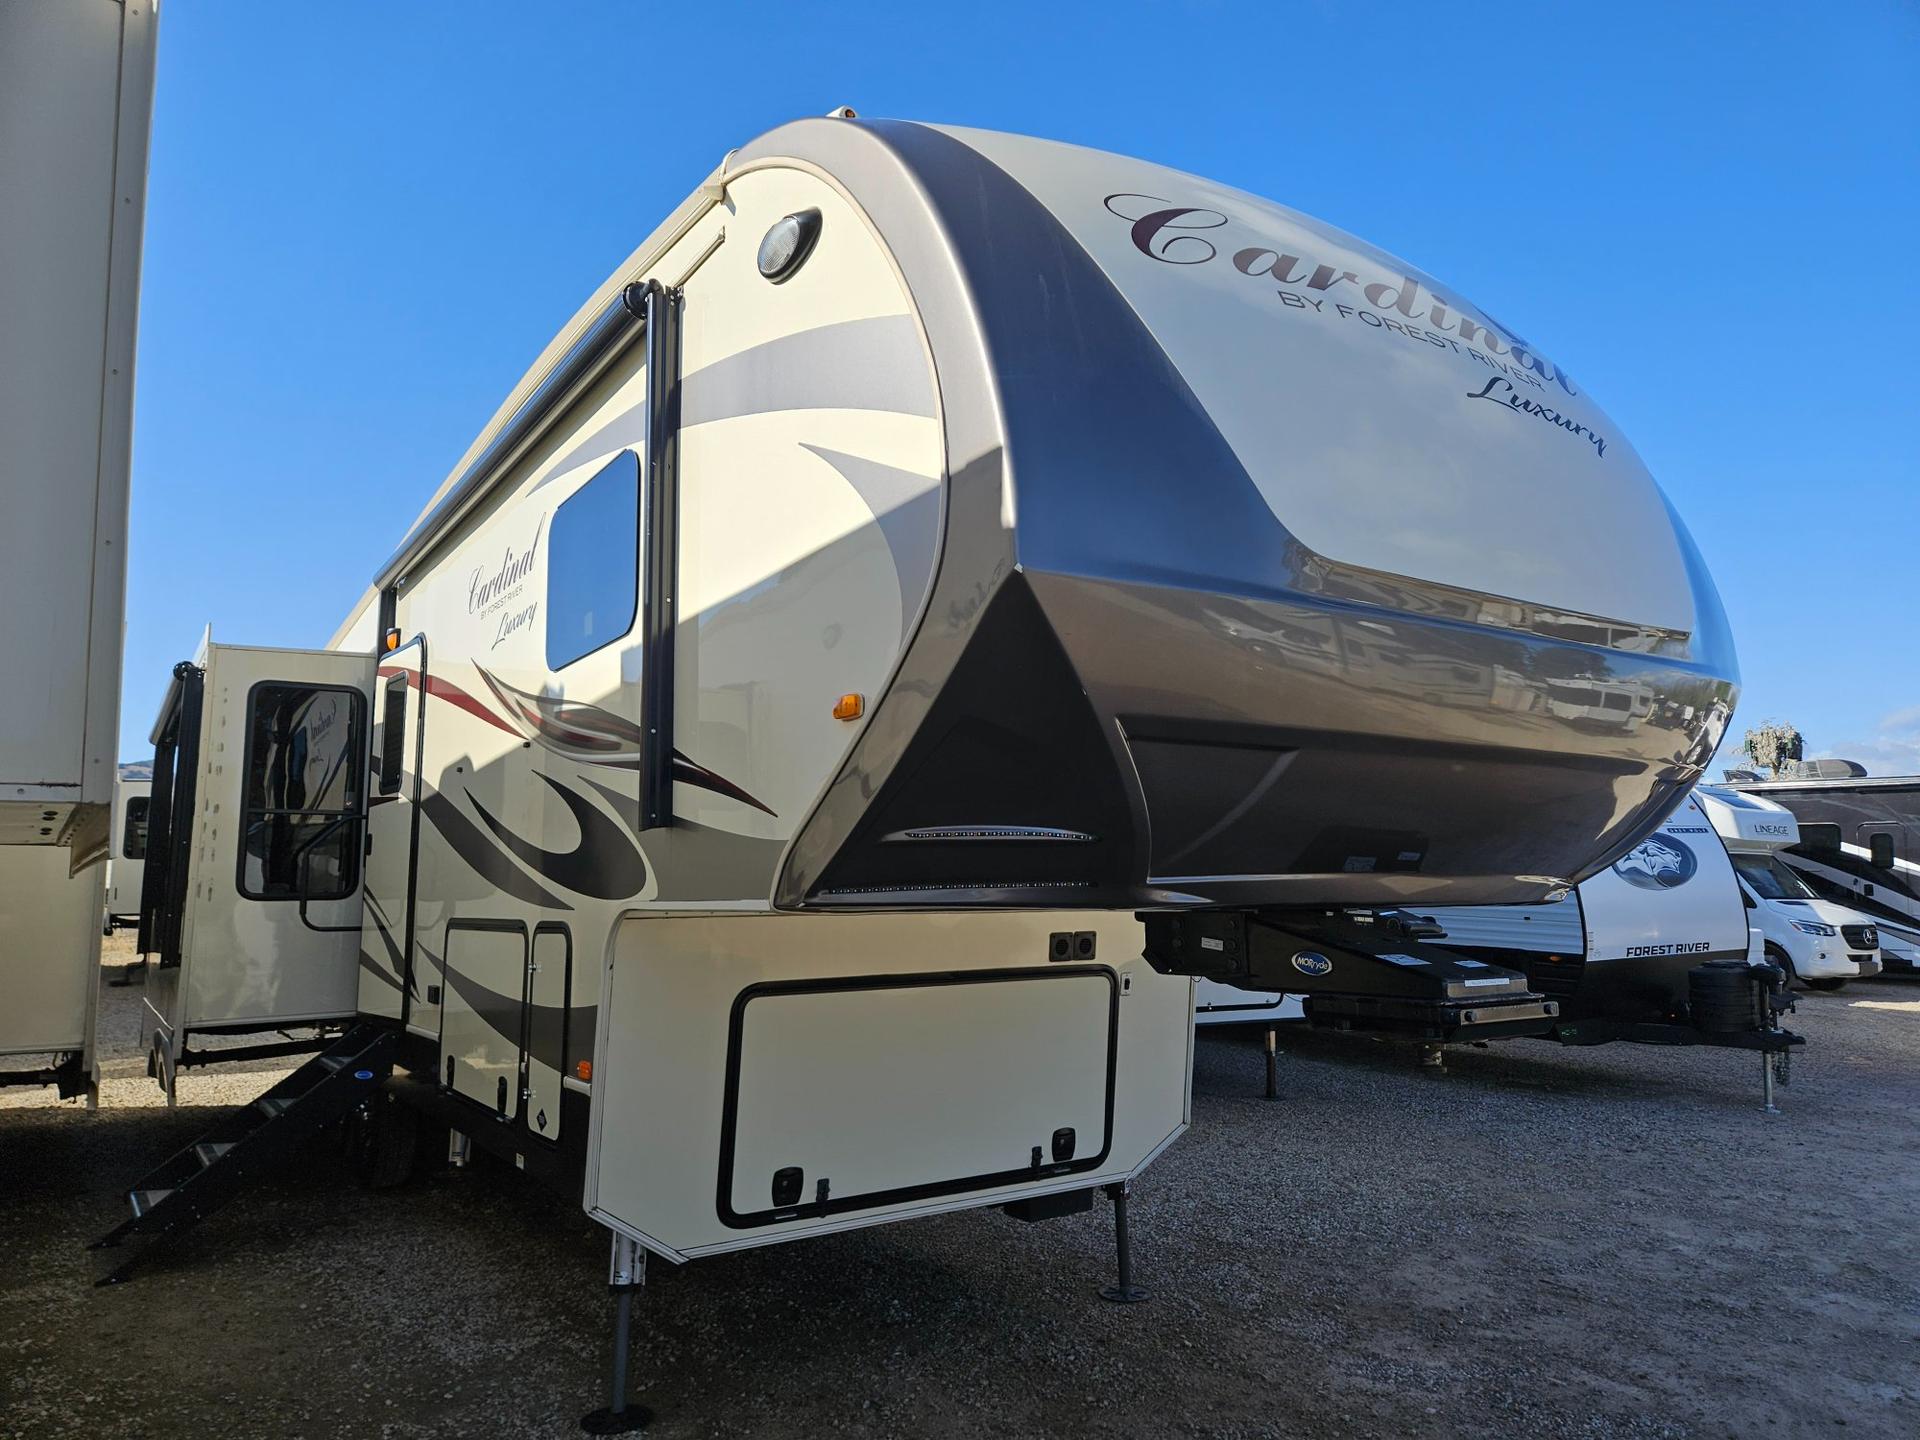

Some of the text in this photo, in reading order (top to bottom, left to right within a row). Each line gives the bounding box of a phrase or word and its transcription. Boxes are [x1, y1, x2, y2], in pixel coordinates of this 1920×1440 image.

[1277, 290, 1546, 393] BY FOREST RIVER
[1466, 376, 1607, 459] Luxury
[469, 512, 546, 614] Cardinal
[491, 601, 537, 651] Luxury
[1754, 824, 1789, 835] LINEAGE
[1626, 942, 1710, 957] FOREST RIVER
